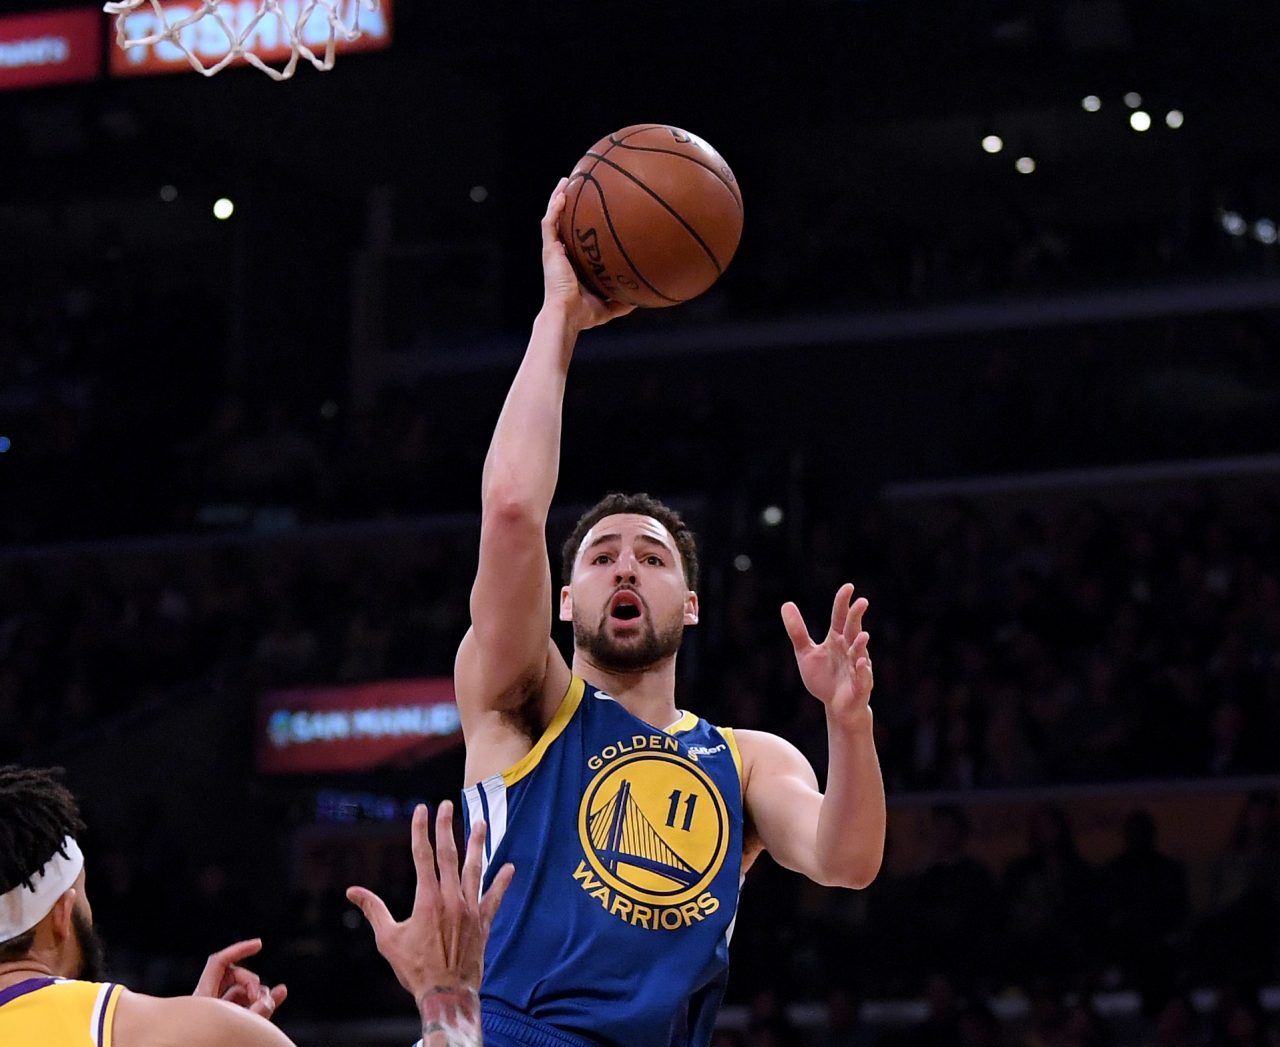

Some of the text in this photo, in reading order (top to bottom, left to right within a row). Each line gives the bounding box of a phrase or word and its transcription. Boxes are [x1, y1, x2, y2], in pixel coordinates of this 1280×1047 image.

[587, 735, 679, 770] GOLDEN
[665, 789, 698, 832] 11
[572, 859, 720, 931] WARRIORS
